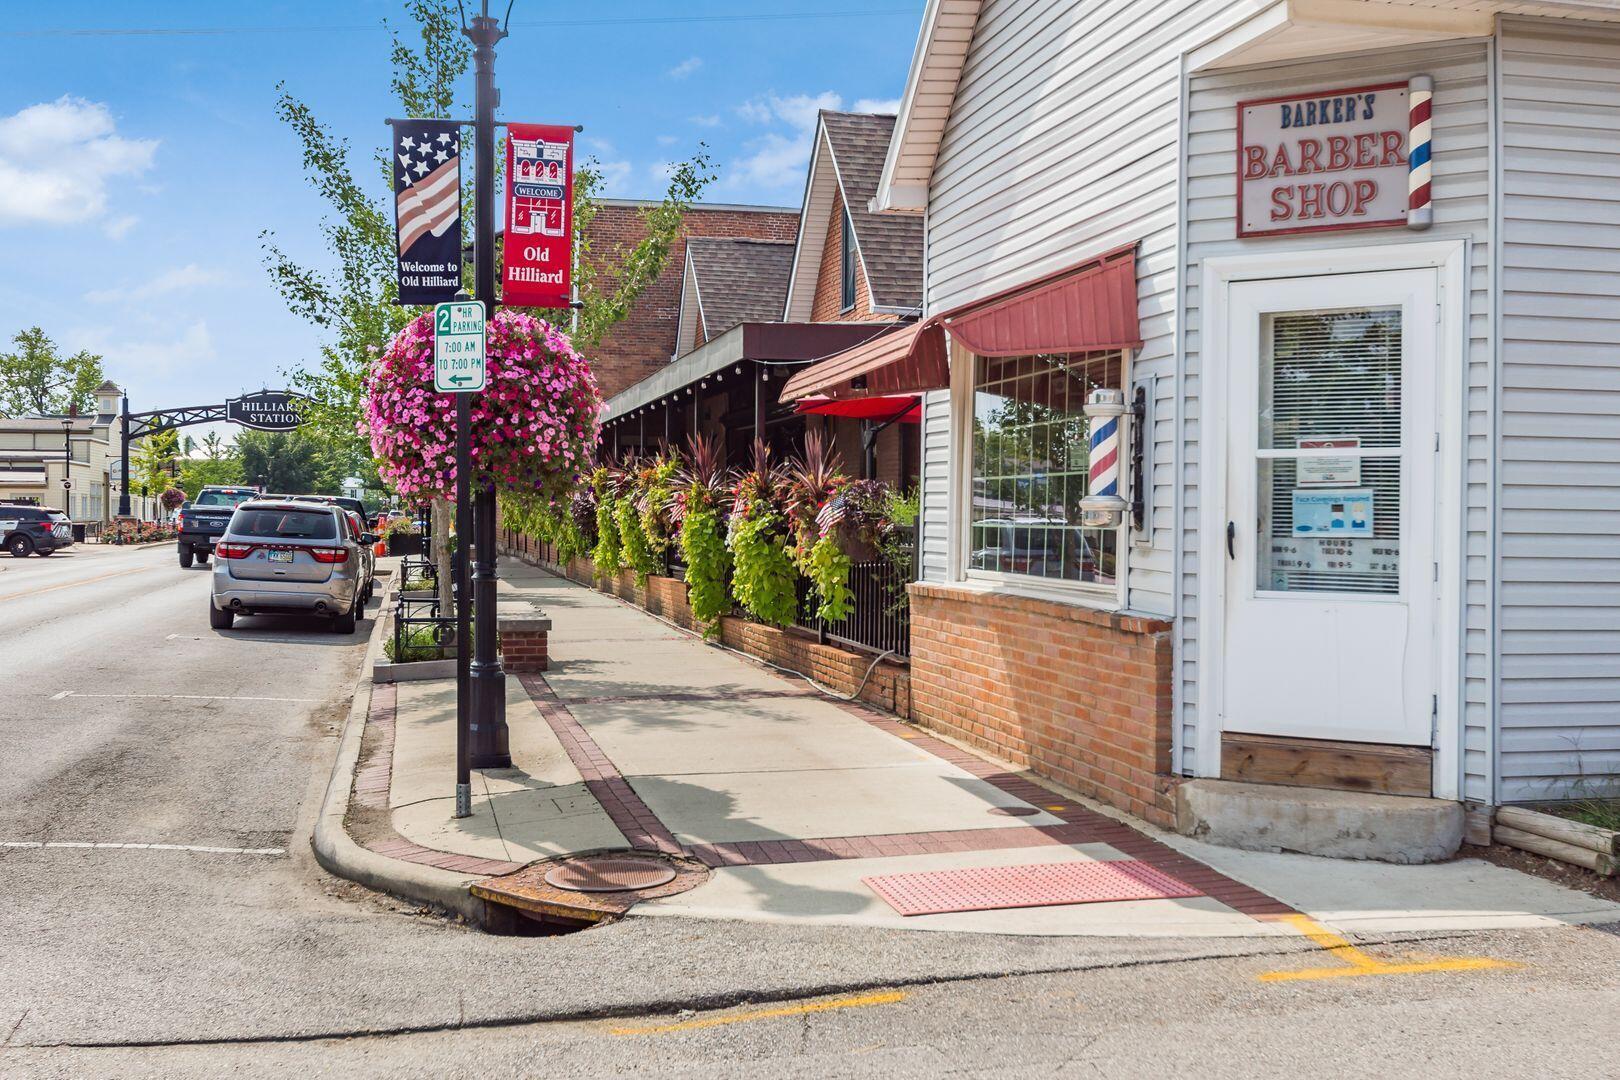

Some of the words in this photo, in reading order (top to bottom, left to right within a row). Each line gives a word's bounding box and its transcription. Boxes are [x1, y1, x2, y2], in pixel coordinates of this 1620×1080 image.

[1280, 94, 1376, 129] BARKER'S
[1244, 130, 1409, 181] BARBER
[518, 187, 559, 197] WELCOME
[1270, 179, 1378, 222] SHOP
[523, 246, 550, 262] Old
[401, 261, 445, 272] Welcome
[447, 262, 458, 272] to
[508, 266, 563, 284] Hilliard
[401, 276, 419, 287] Old
[422, 276, 459, 287] Hilliard
[438, 309, 450, 331] 2
[462, 307, 473, 318] HR
[453, 320, 482, 332] PARKING
[445, 342, 461, 353] 7:00
[464, 341, 476, 352] AM
[439, 359, 448, 370] TO
[452, 359, 468, 370] 7:00
[471, 358, 482, 369] PM
[250, 413, 303, 423] STATION
